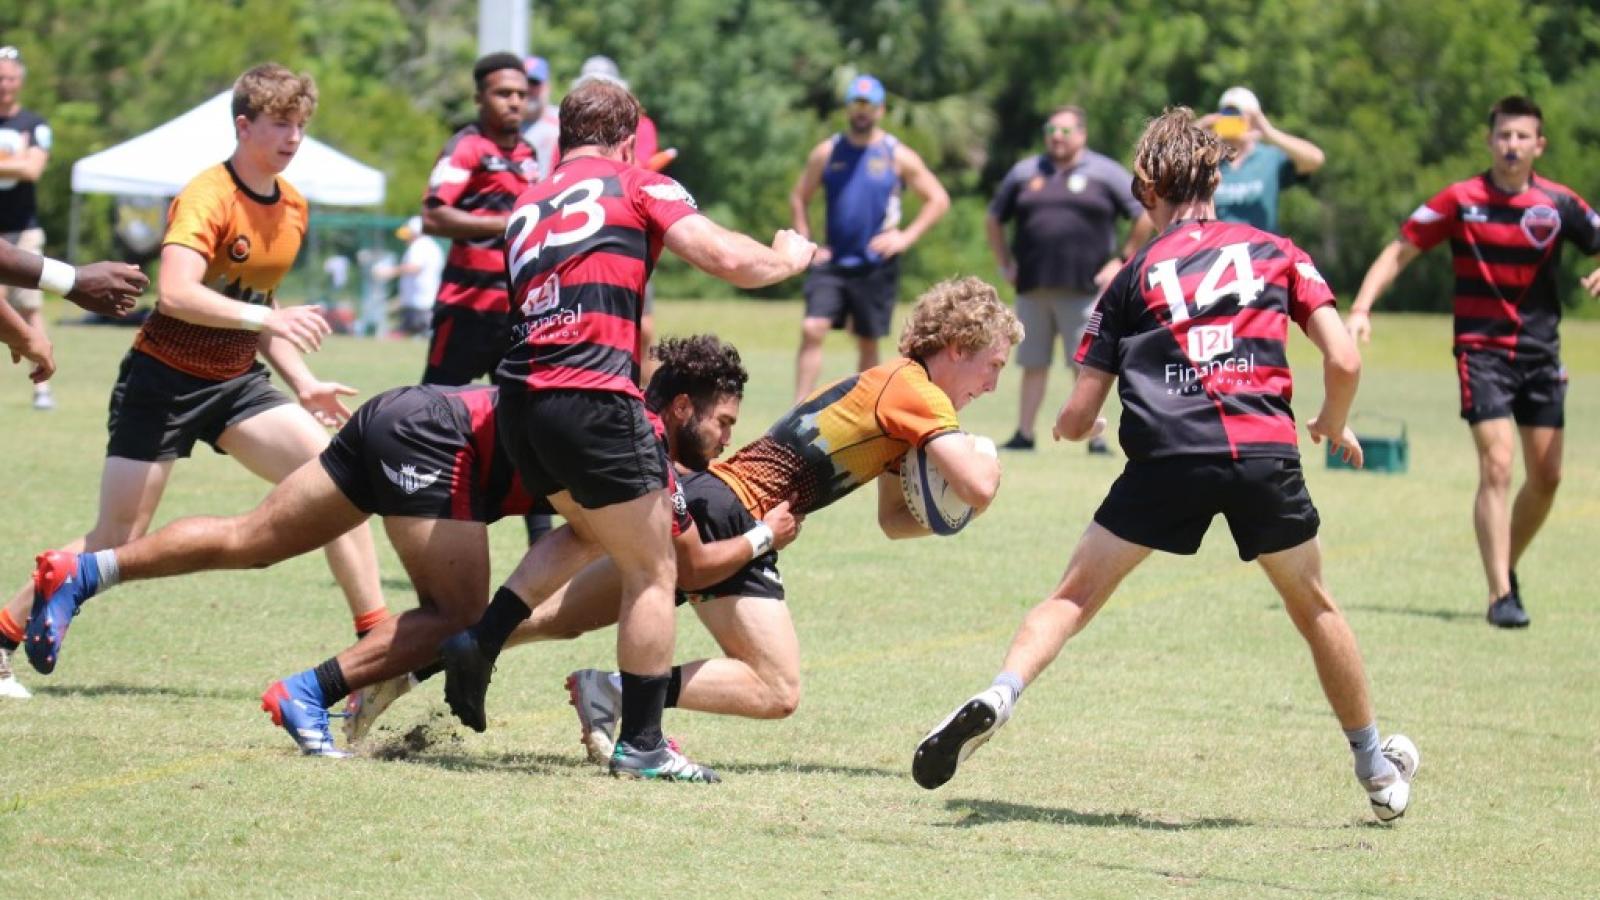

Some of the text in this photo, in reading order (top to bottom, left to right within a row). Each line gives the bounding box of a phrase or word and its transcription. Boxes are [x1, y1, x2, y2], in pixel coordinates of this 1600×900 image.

[505, 178, 606, 289] 23
[1148, 243, 1264, 323] 14
[1165, 353, 1254, 384] Financal
